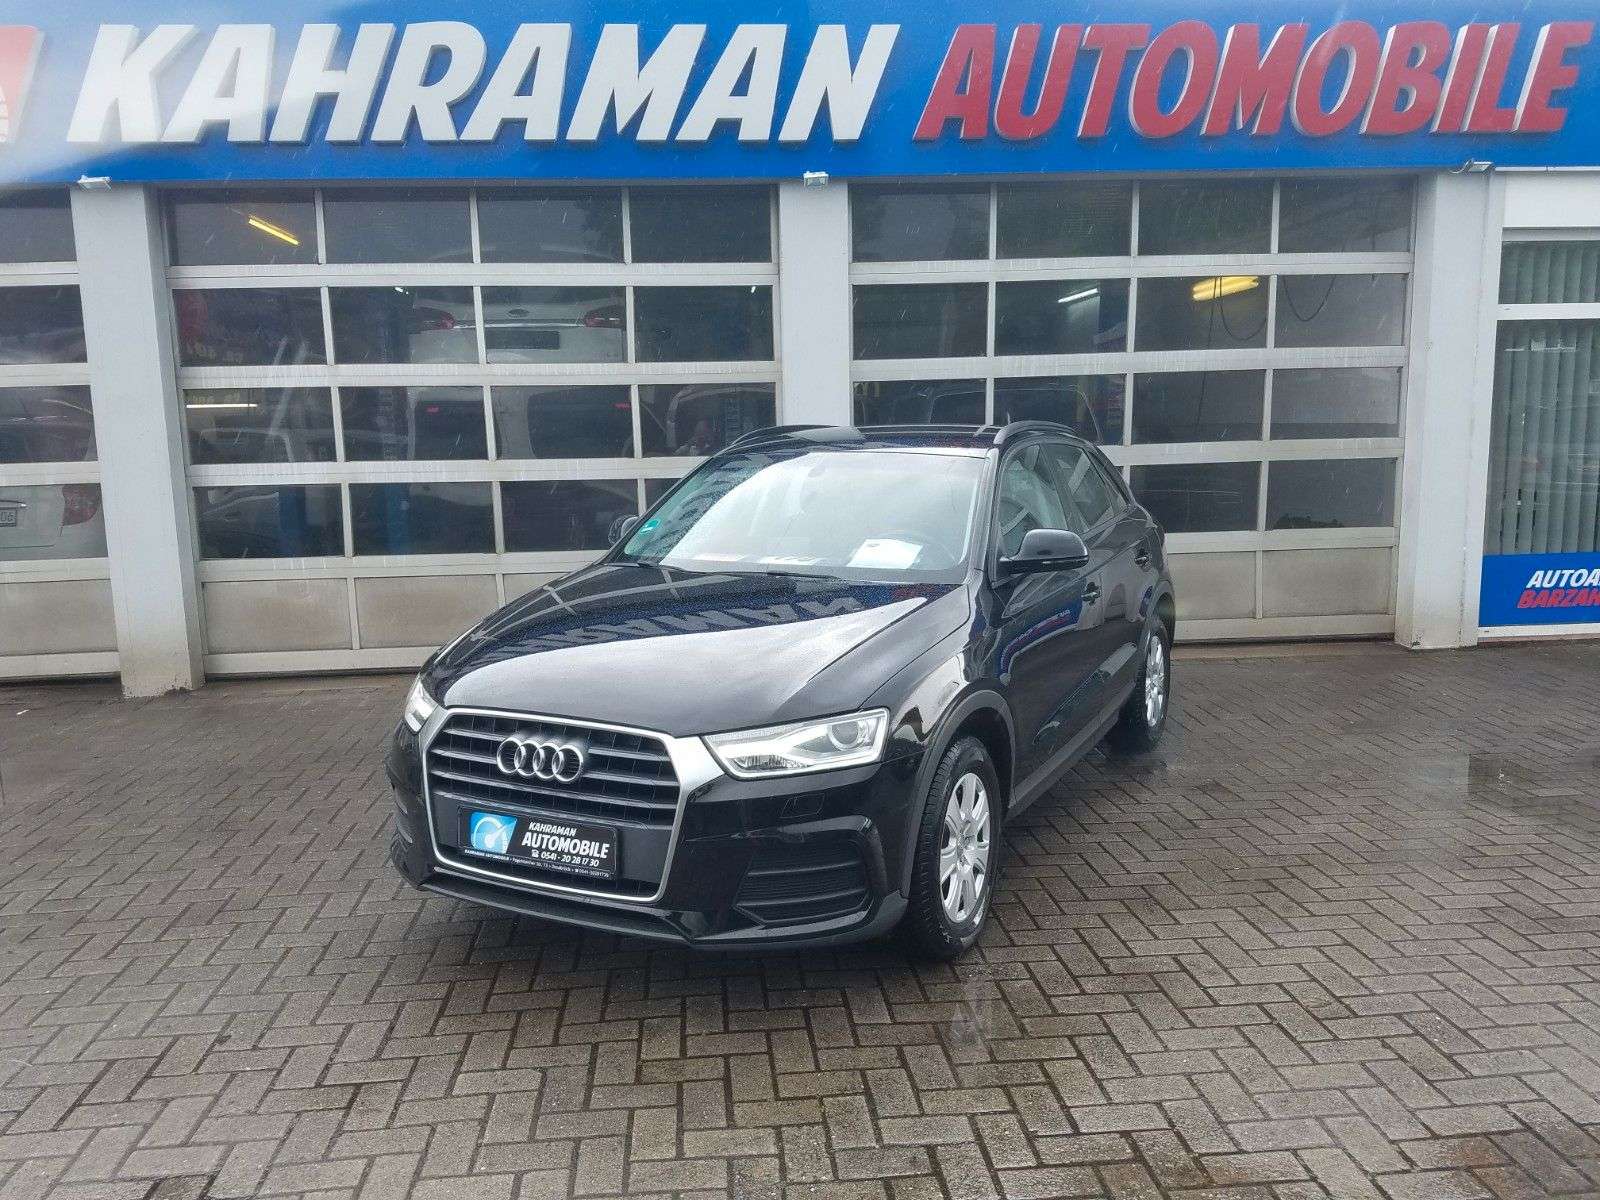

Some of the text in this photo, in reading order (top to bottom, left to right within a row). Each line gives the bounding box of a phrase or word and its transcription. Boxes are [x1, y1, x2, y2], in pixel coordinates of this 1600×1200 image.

[67, 20, 1596, 144] KAHRAMAN AUTOMOBILE
[1526, 568, 1600, 588] AUTOA
[528, 821, 577, 837] KAHRAMAN
[521, 831, 610, 859] AUTOMOBILE
[541, 851, 557, 861] 0541
[561, 854, 571, 863] 20
[571, 856, 581, 864] 28
[589, 859, 600, 867] 30
